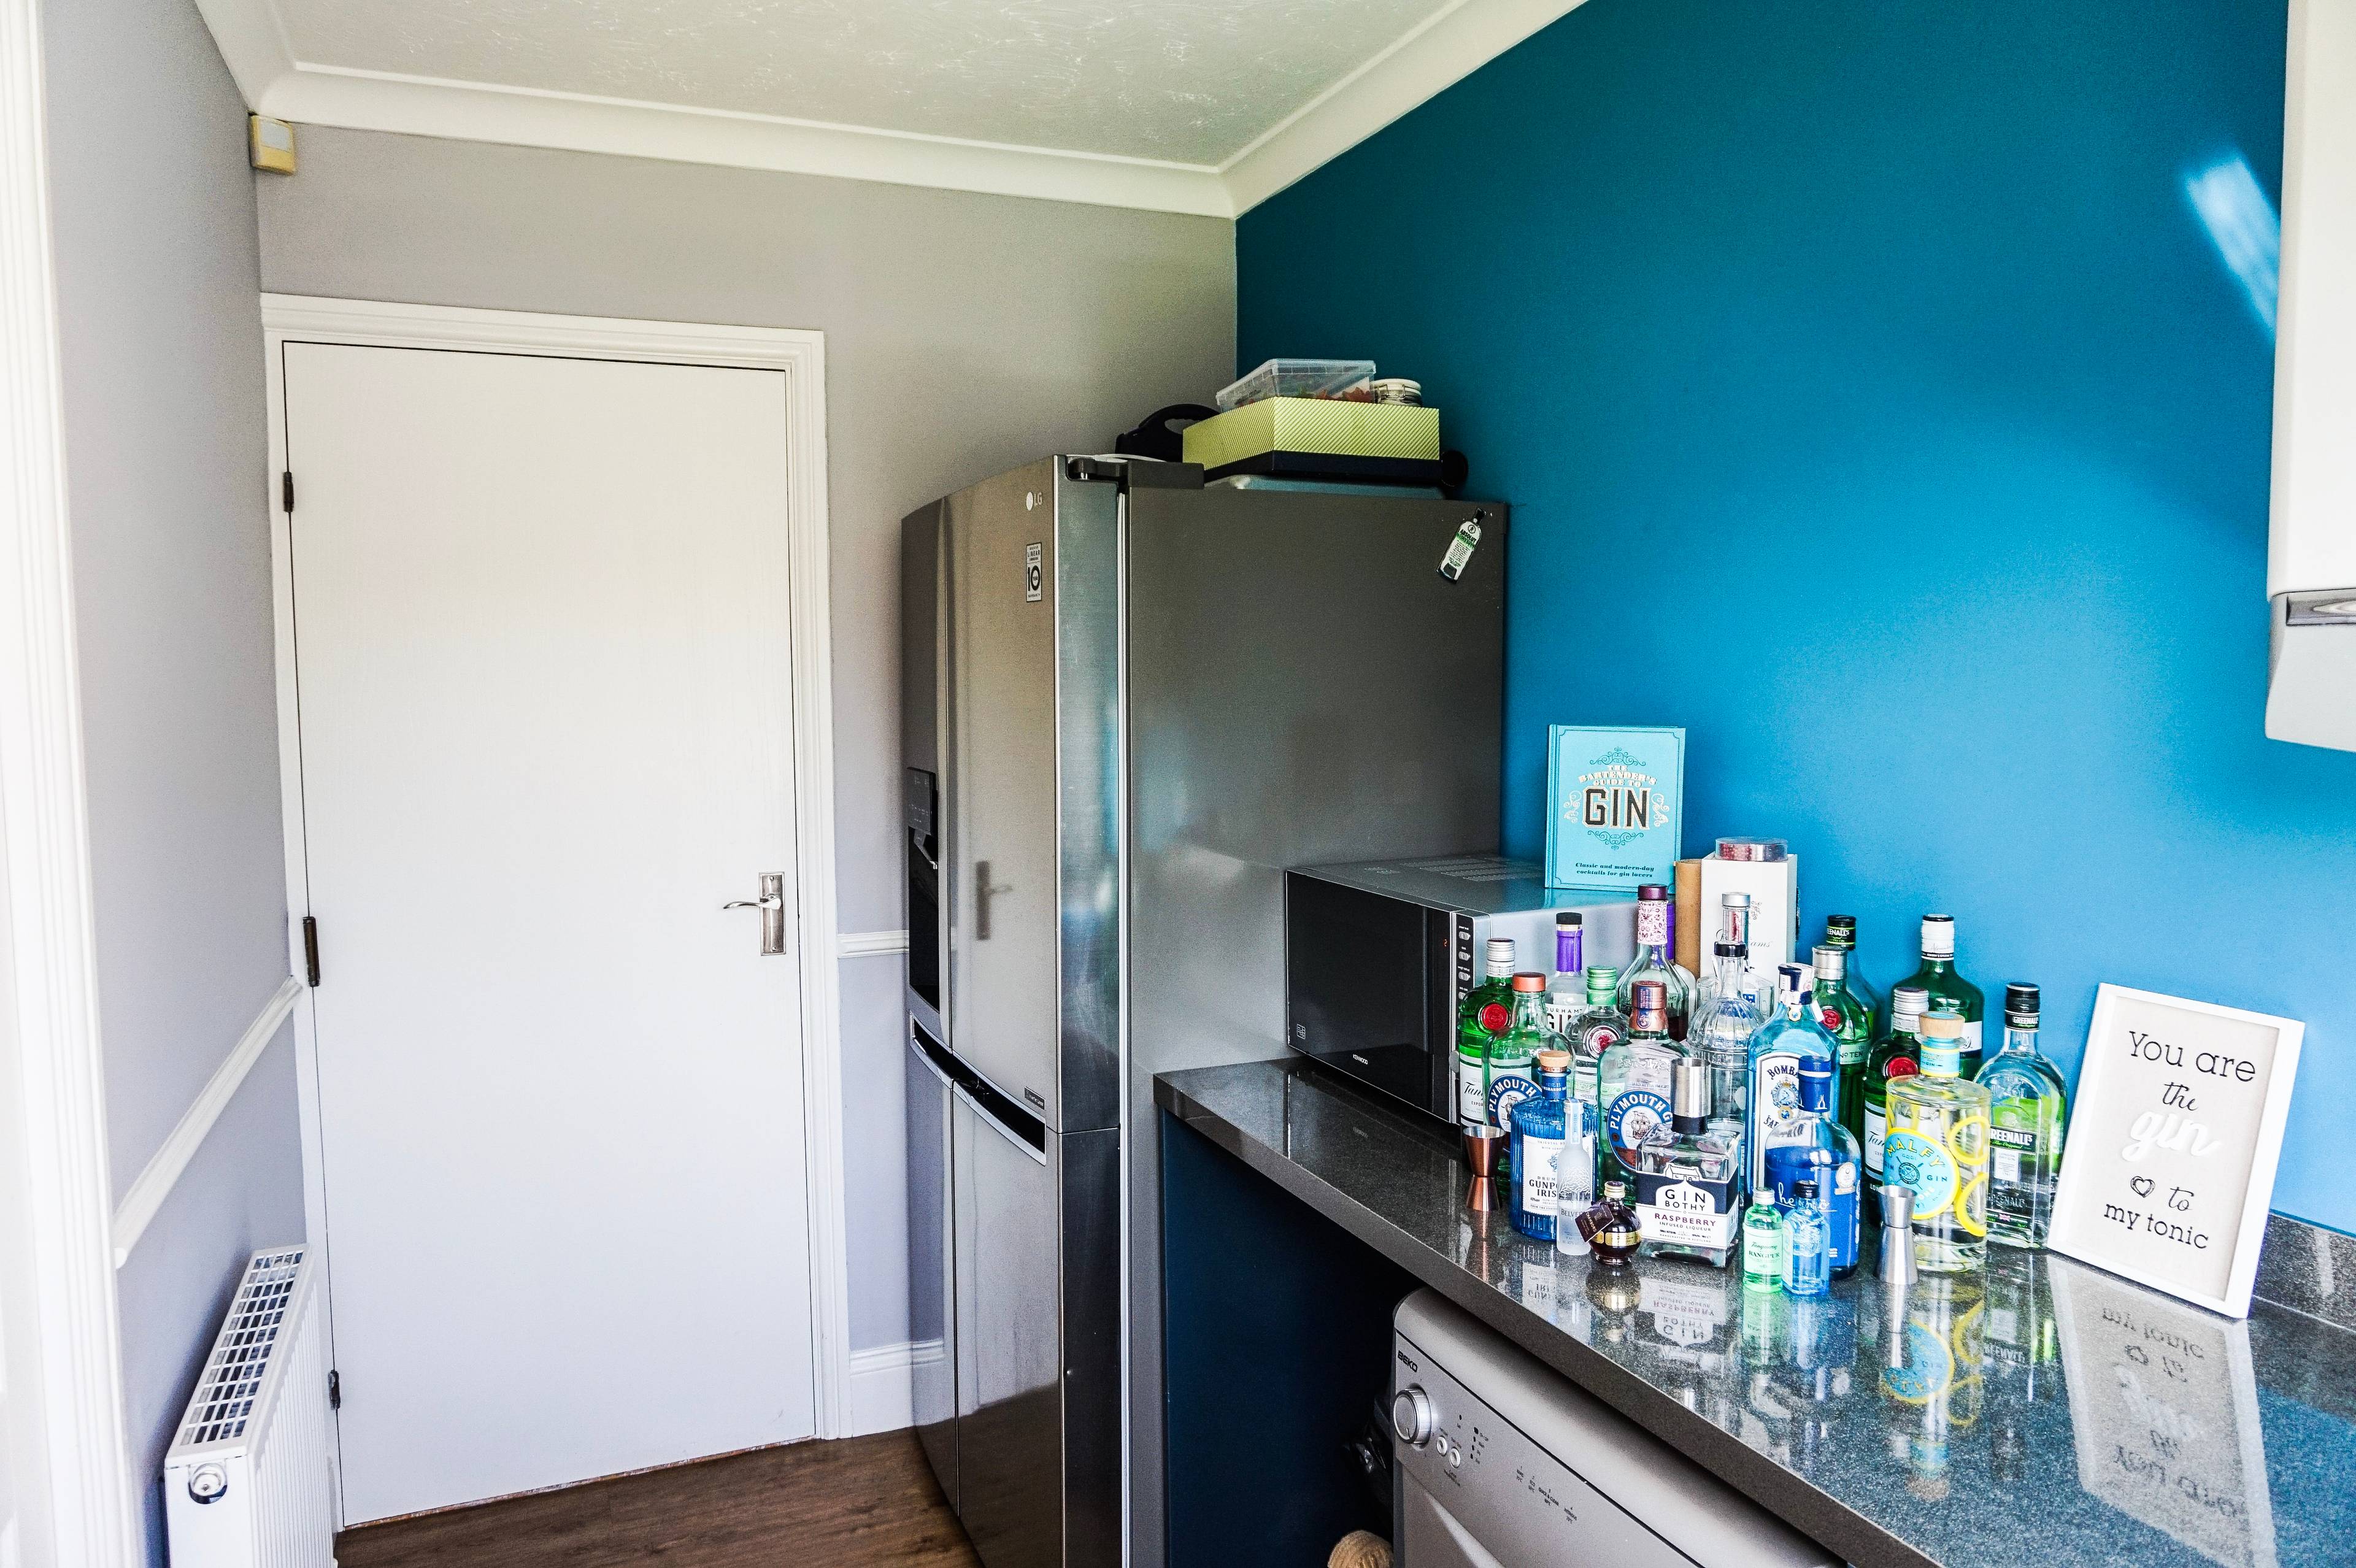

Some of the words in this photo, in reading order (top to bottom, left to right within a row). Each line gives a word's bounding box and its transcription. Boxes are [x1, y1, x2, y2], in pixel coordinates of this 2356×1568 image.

[1034, 492, 1042, 505] LG
[1460, 529, 1477, 543] ABSOLUT
[1028, 565, 1041, 591] 10
[1577, 771, 1657, 786] BARTENDER'S
[1582, 786, 1652, 830] GIN
[1353, 1053, 1368, 1065] KENWOOD
[2128, 1031, 2183, 1067] You
[2196, 1052, 2256, 1082] are
[1489, 1078, 1537, 1112] PLYMOUTH
[2162, 1082, 2200, 1111] the
[1610, 1094, 1666, 1130] PLYMOUTH
[1990, 1129, 2033, 1145] REENALL'S
[2122, 1111, 2222, 1162] gin
[1886, 1138, 1946, 1167] MALFY
[1537, 1189, 1557, 1197] IRIS
[1665, 1189, 1706, 1204] GIN
[2168, 1186, 2195, 1212] to
[1665, 1200, 1706, 1212] BOTHY
[1654, 1213, 1717, 1227] RASPBERRY
[2103, 1202, 2141, 1231] my
[2147, 1213, 2209, 1250] tonic
[1751, 1242, 1777, 1250] Tanqueray
[1398, 1350, 1418, 1373] BEKO
